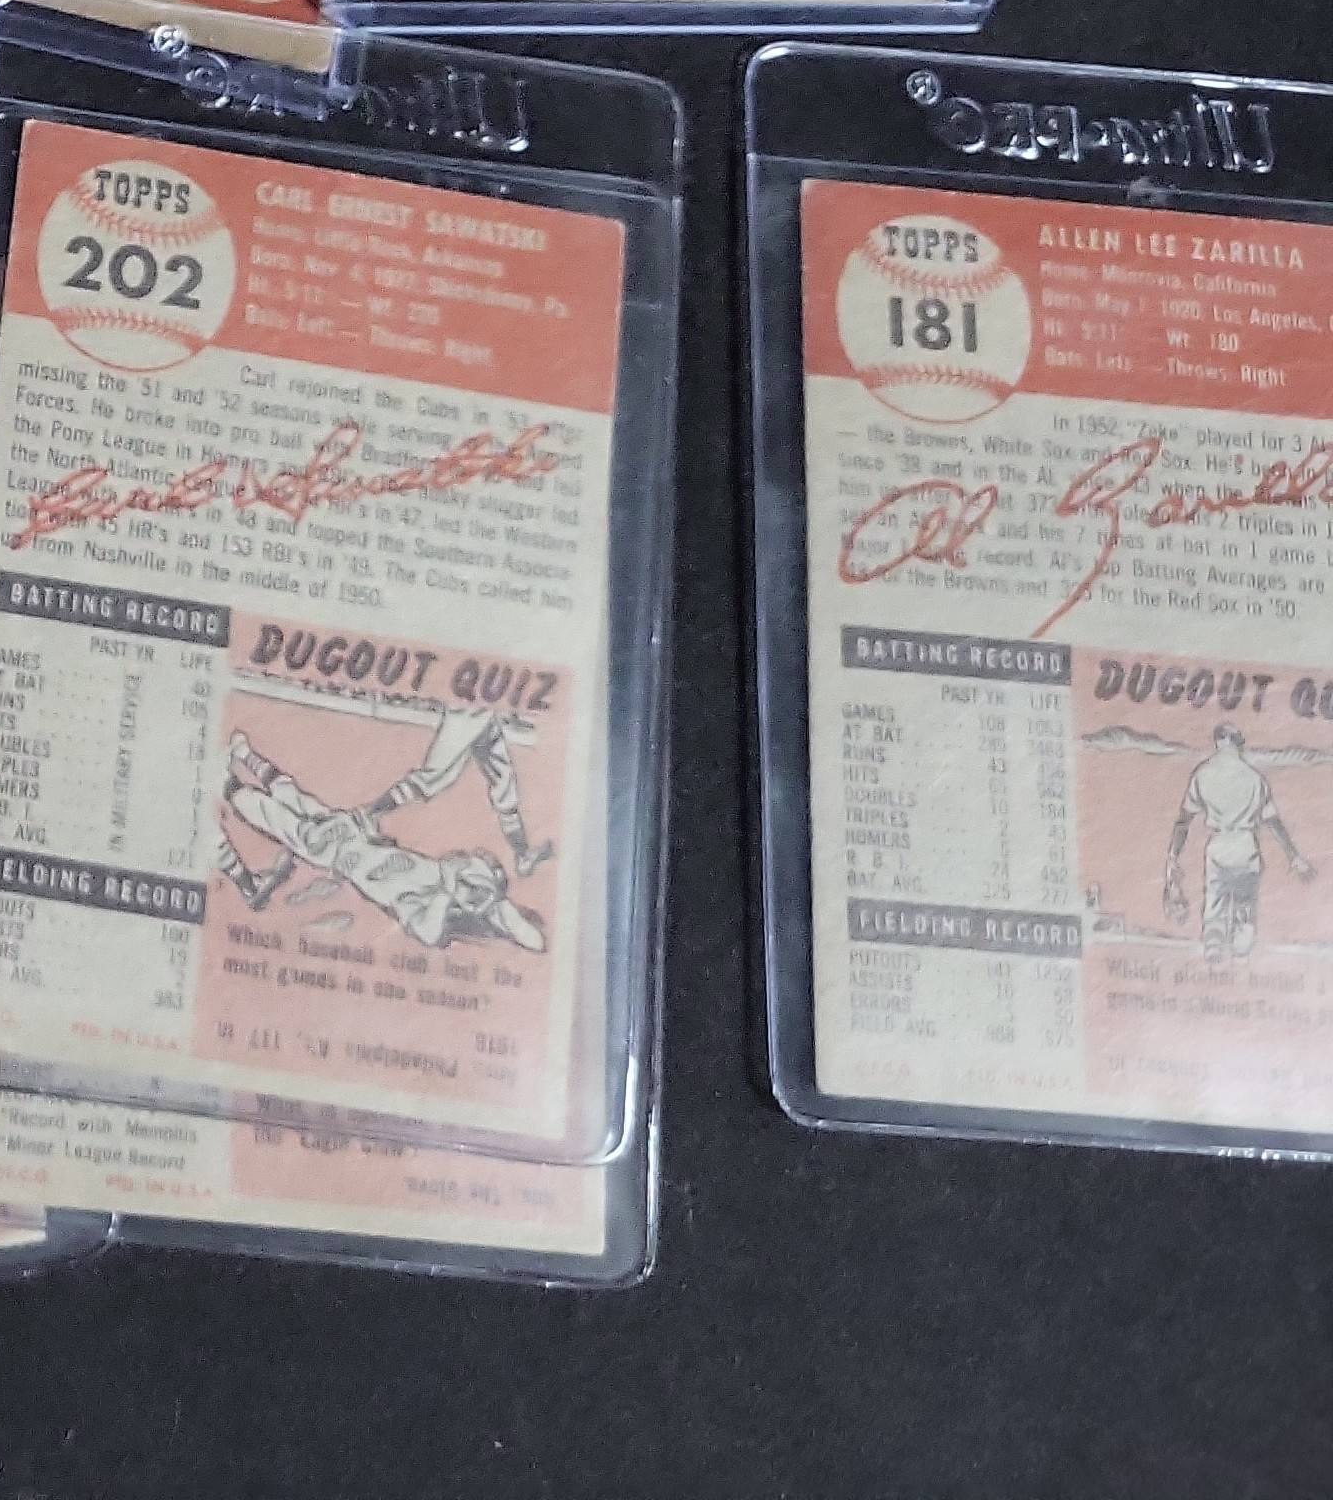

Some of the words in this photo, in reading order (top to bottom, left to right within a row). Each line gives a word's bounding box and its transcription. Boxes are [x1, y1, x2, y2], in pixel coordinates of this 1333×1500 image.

[94, 171, 190, 213] TOPPS
[883, 225, 979, 262] TOPPS
[1039, 222, 1121, 254] ALLEN
[1137, 232, 1177, 257] LEE
[1192, 234, 1304, 270] ZARILLA
[65, 235, 204, 310] 202
[887, 298, 978, 354] 181
[9, 582, 112, 617] BATTING
[124, 601, 218, 634] RECORD
[252, 623, 440, 688] DUGOUT
[451, 661, 557, 712] QUIZ
[857, 638, 958, 666] BATTING
[969, 645, 1064, 672] RECORD
[1094, 660, 1273, 712] DUGOUT
